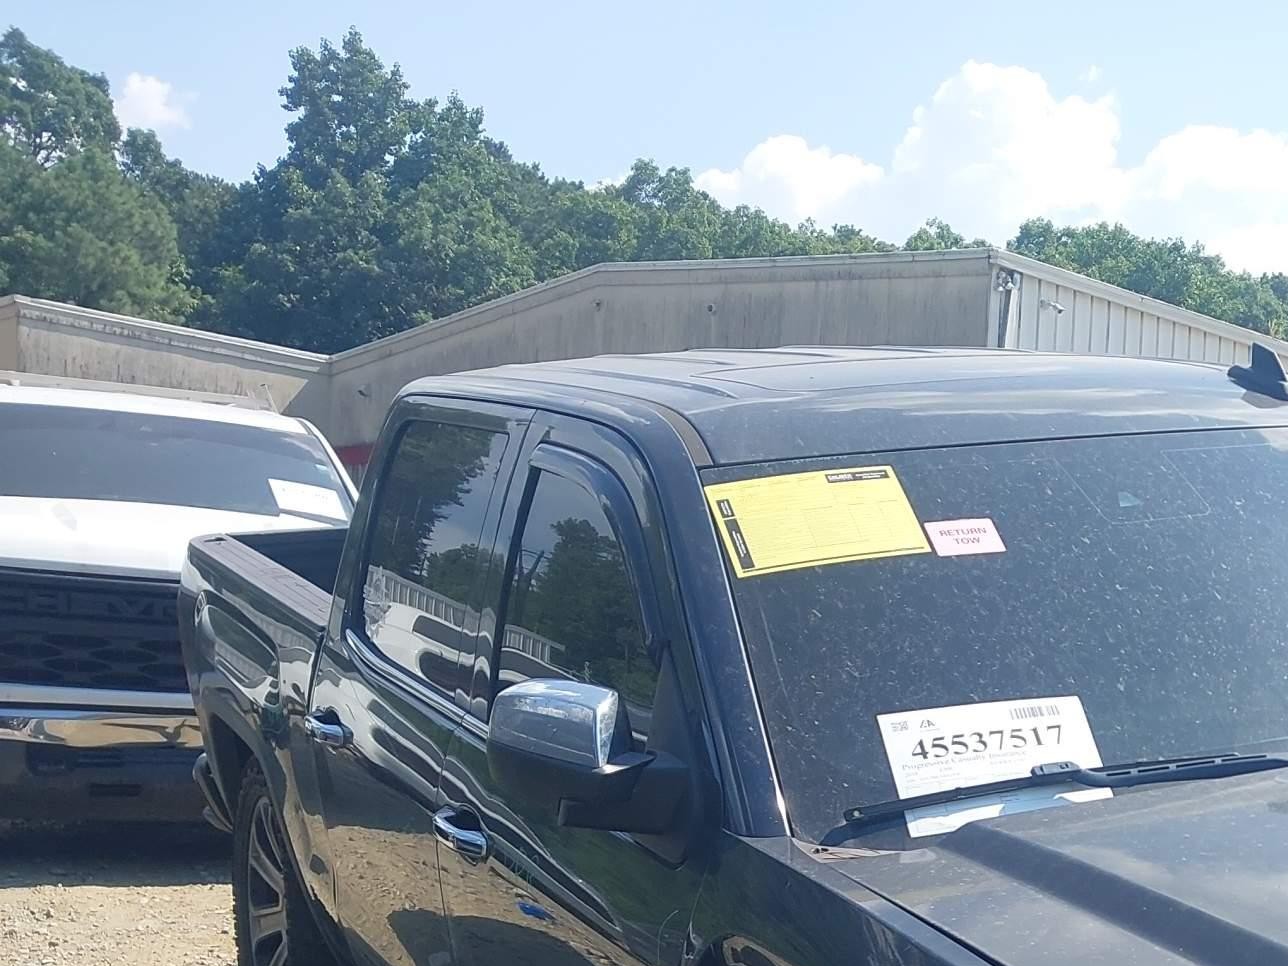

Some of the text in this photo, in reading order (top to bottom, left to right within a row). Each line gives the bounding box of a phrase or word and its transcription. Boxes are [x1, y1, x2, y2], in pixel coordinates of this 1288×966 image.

[939, 527, 987, 537] RETURN
[954, 536, 980, 545] TOW
[911, 724, 1062, 760] 45537517
